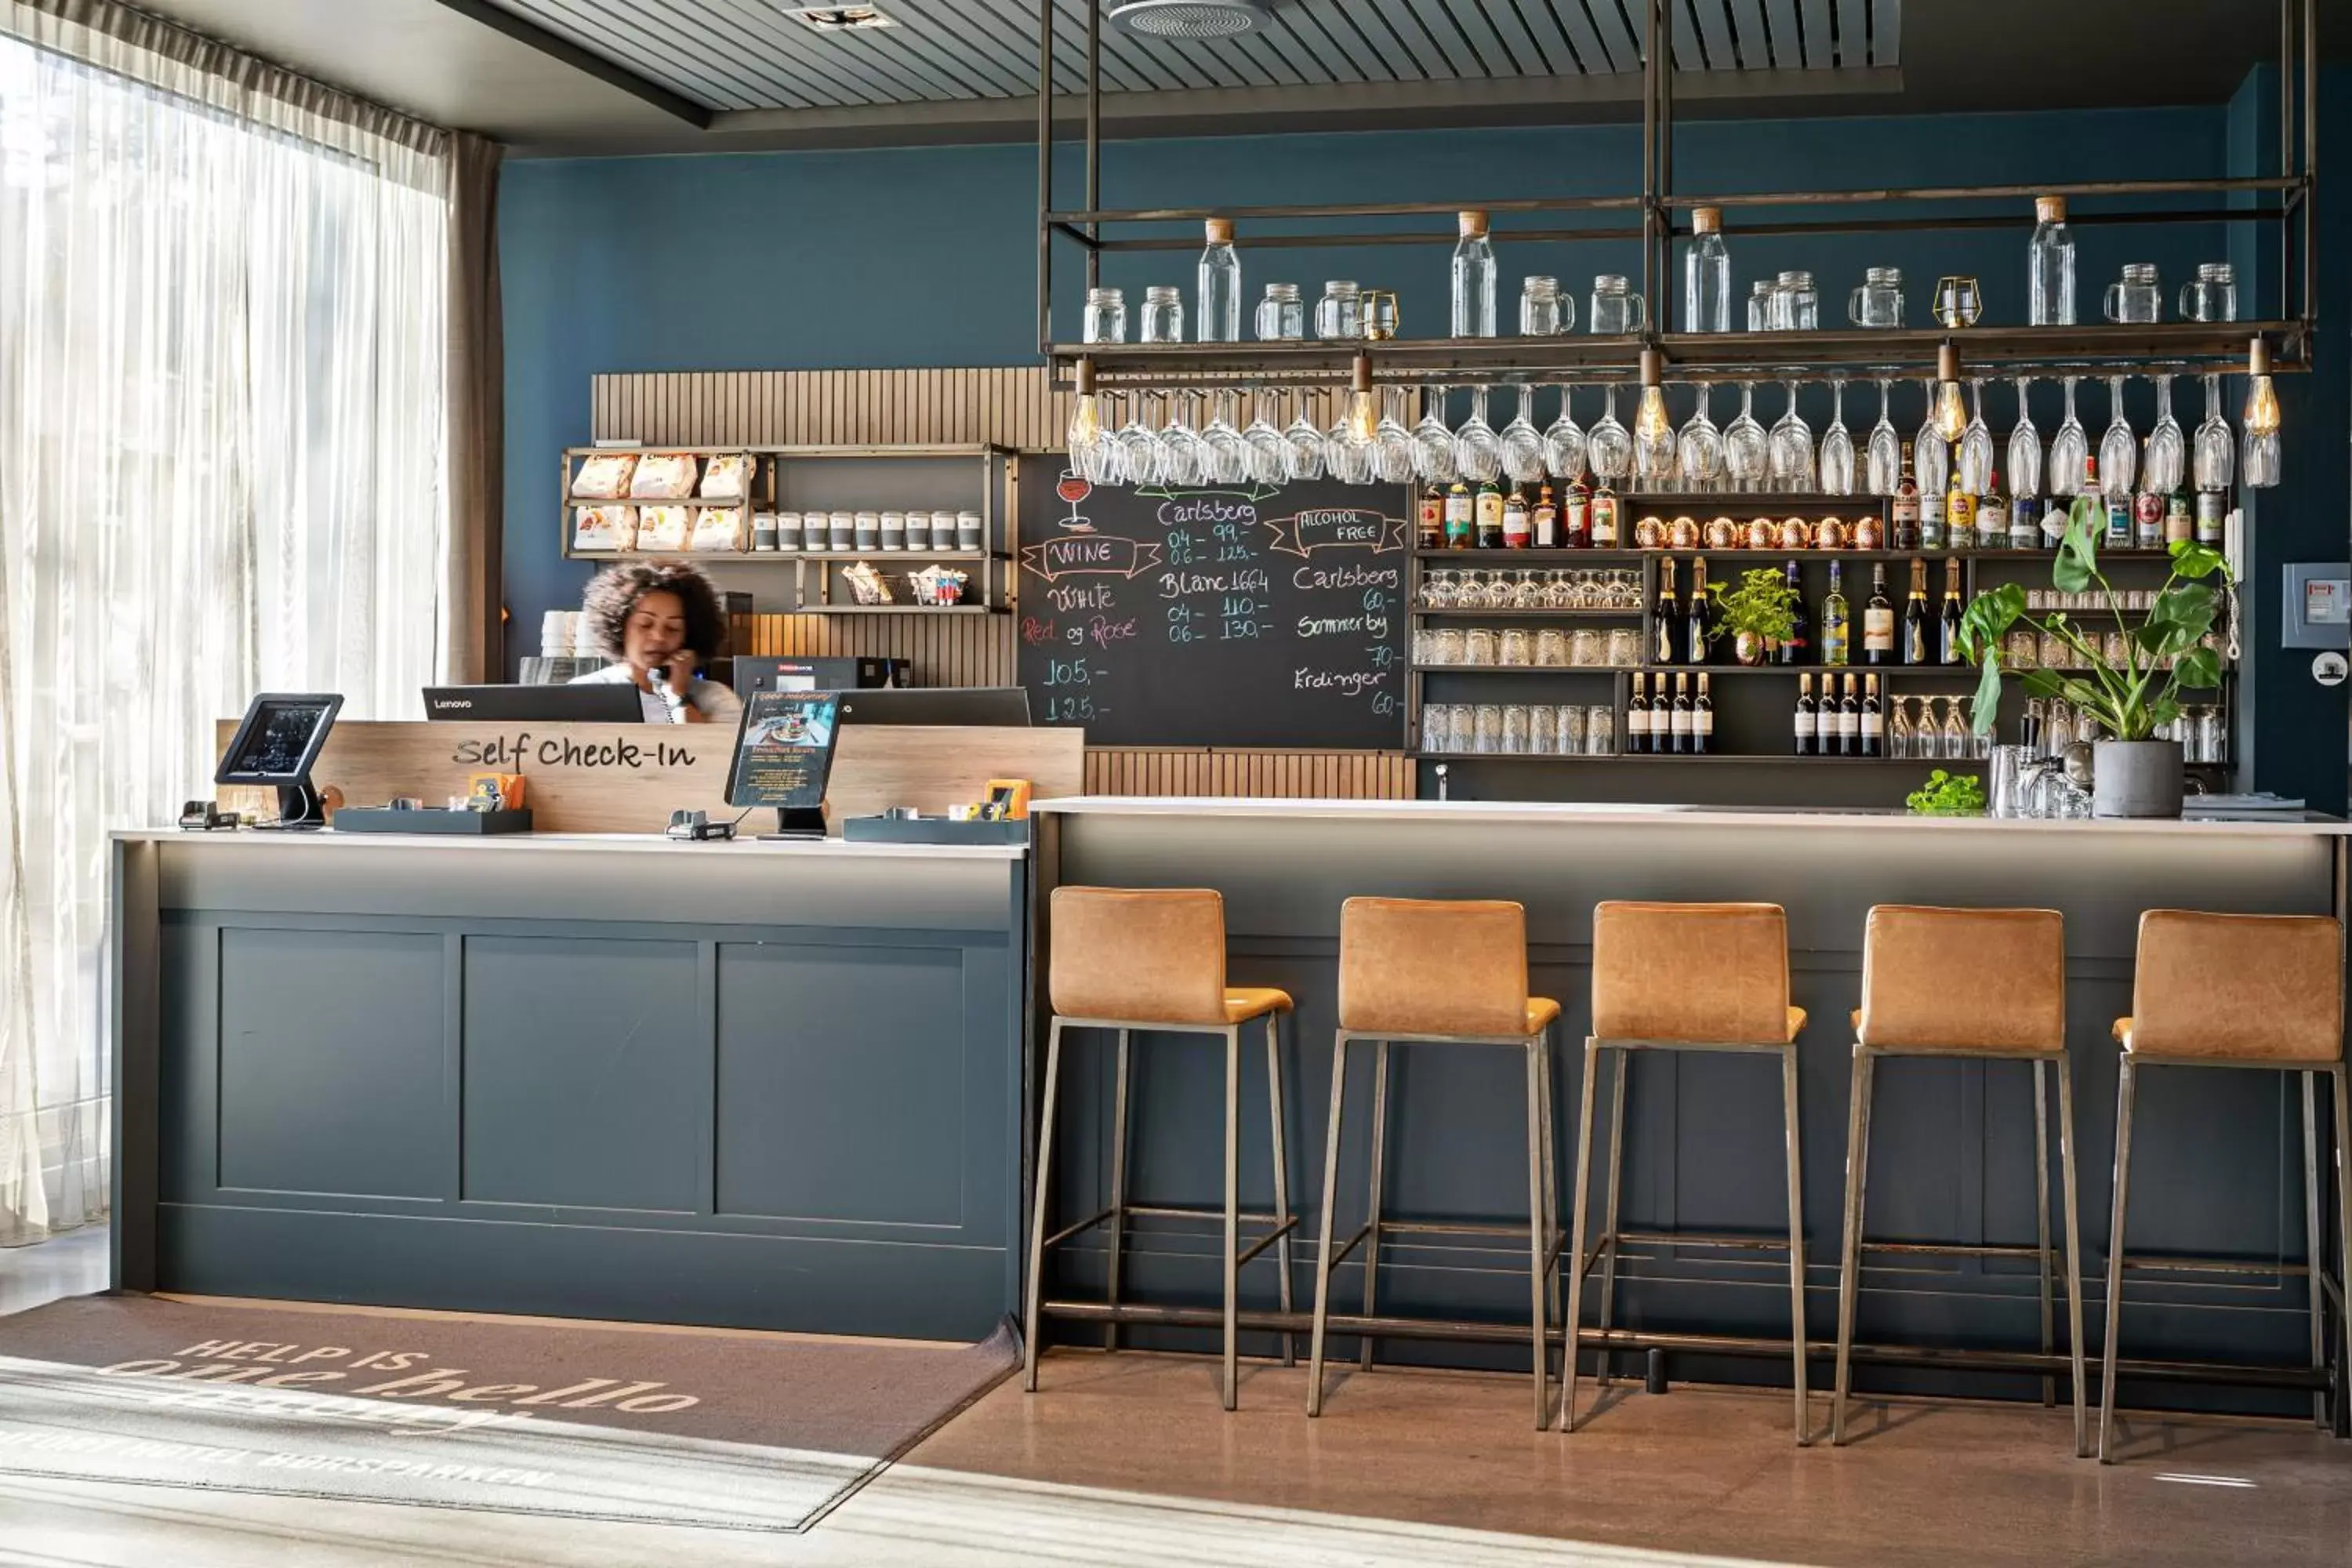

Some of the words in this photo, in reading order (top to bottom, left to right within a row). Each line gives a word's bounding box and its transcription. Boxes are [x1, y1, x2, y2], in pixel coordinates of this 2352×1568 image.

[1157, 499, 1257, 526] Carlsberg
[1301, 510, 1363, 529] ALCOHOL
[1337, 525, 1377, 540] FREE
[1049, 541, 1112, 564] WINE
[1158, 571, 1229, 598] Blanc
[1229, 568, 1269, 593] 1664
[1293, 564, 1399, 590] Carlsberg
[1022, 616, 1058, 647] Red
[1066, 626, 1083, 645] og
[1294, 666, 1388, 696] Erdinger
[434, 699, 472, 710] Lenovo
[452, 733, 532, 775] Self
[538, 736, 697, 770] Check-In
[173, 1339, 351, 1364] HELP
[347, 1350, 430, 1370] IS
[97, 1359, 348, 1388] one
[347, 1367, 701, 1413] hello
